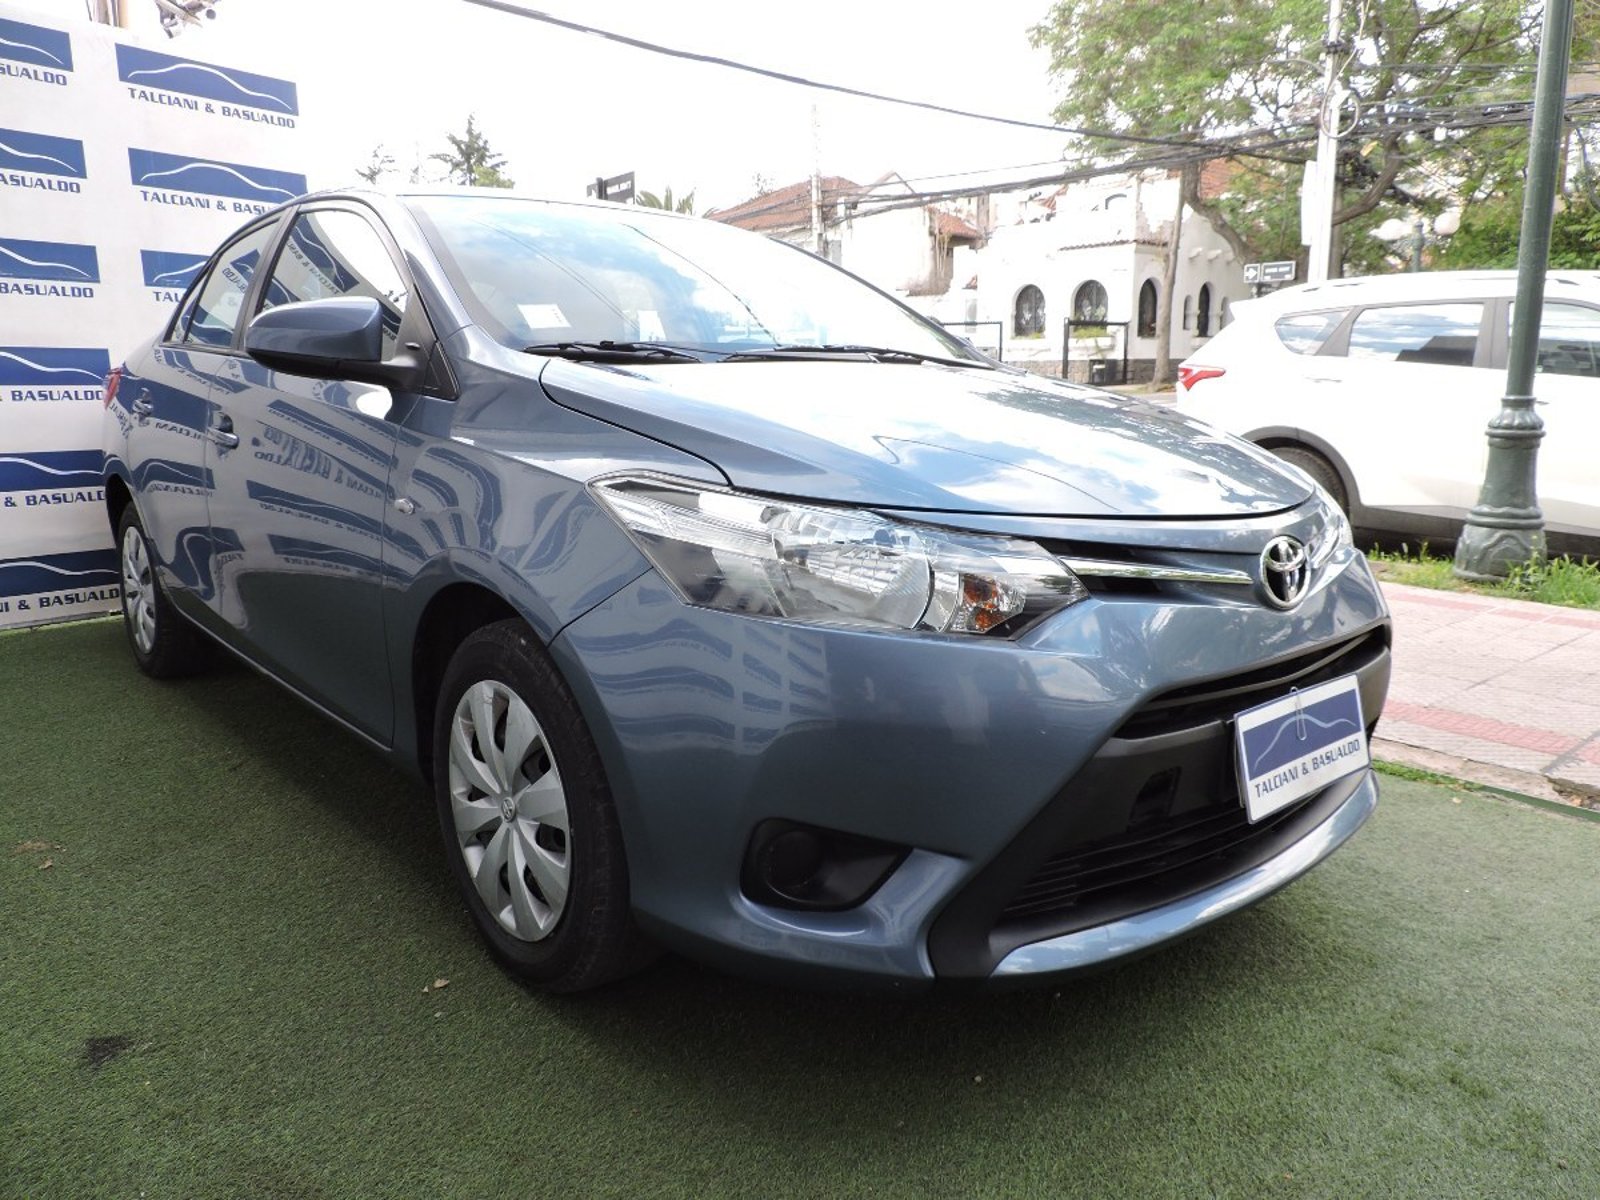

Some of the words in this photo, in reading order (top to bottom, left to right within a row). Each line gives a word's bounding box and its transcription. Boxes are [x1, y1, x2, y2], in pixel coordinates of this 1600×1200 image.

[128, 87, 199, 111] TALCIANI
[204, 103, 216, 114] &
[221, 106, 296, 129] BASUALDO
[140, 190, 210, 209] TALCIANI
[216, 200, 227, 211] &
[0, 282, 94, 298] BASUALDO
[4, 496, 17, 507] &
[18, 599, 31, 610] &
[1255, 766, 1298, 796] TALCIANI
[1302, 761, 1310, 776] &
[1312, 739, 1361, 770] BASUALDO
